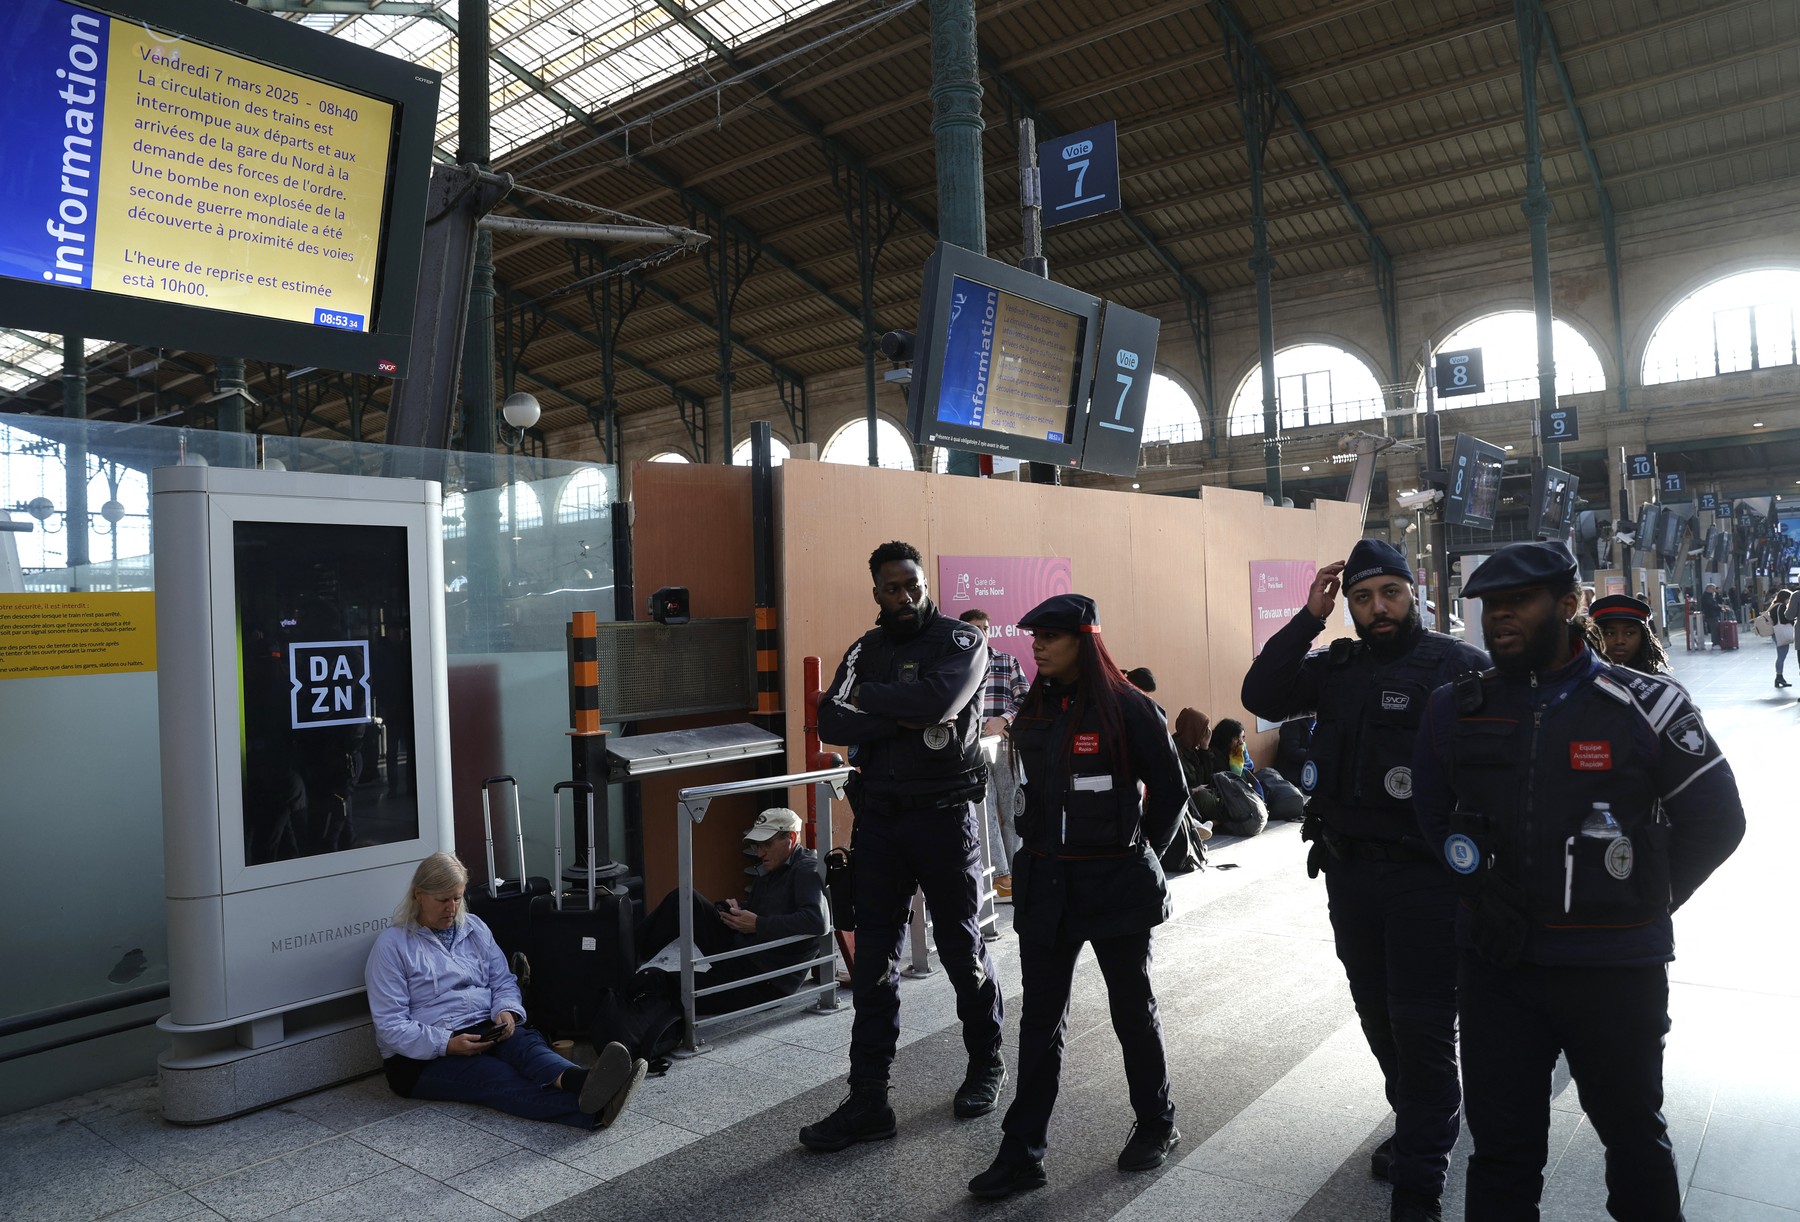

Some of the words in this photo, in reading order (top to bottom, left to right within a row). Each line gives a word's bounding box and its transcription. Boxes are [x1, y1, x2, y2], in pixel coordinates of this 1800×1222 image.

[140, 46, 209, 79] Vendredi
[214, 68, 223, 82] 7
[227, 76, 261, 94] mars
[265, 84, 299, 105] 2025
[319, 100, 358, 122] 08h40
[138, 69, 156, 87] La
[161, 78, 240, 110] circulation
[245, 101, 268, 118] des
[273, 109, 310, 130] trains
[314, 123, 334, 136] est
[136, 92, 232, 130] interrompue
[235, 122, 260, 137] aux
[263, 128, 314, 152] départs
[317, 144, 331, 156] et
[334, 149, 356, 162] aux
[43, 13, 100, 285] information
[134, 118, 195, 142] arrivées
[199, 133, 217, 148] de
[221, 137, 233, 152] la
[237, 144, 267, 160] gare
[271, 152, 288, 166] du
[292, 155, 325, 175] Nord
[327, 165, 335, 178] à
[338, 167, 349, 181] la
[1066, 144, 1089, 158] Voie
[133, 138, 205, 167] demande
[208, 157, 233, 174] des
[237, 163, 279, 185] forces
[283, 176, 299, 189] de
[302, 179, 347, 201] l'ordre.
[1068, 159, 1090, 198] 7
[131, 160, 163, 179] Une
[167, 168, 219, 192] bombe
[223, 184, 250, 199] non
[254, 191, 312, 213] explosée
[315, 204, 331, 217] de
[334, 207, 345, 220] la
[129, 185, 193, 208] seconde
[196, 200, 243, 219] guerre
[246, 211, 309, 233] mondiale
[311, 225, 319, 235] a
[322, 225, 343, 240] été
[128, 206, 213, 234] découverte
[216, 223, 224, 236] à
[228, 228, 294, 250] proximité
[297, 240, 319, 255] des
[322, 248, 354, 262] voies
[124, 249, 180, 271] L'heure
[184, 261, 202, 275] de
[206, 267, 254, 284] reprise
[257, 276, 278, 288] est
[281, 280, 332, 297] estimée
[122, 274, 155, 289] està
[161, 277, 209, 297] 10h00.
[320, 312, 348, 327] 08:53
[348, 320, 358, 328] 34
[378, 363, 396, 371] SNCF
[969, 291, 997, 427] information
[1120, 352, 1136, 368] Voie
[1451, 356, 1468, 364] Voie
[1453, 366, 1468, 386] 8
[1114, 373, 1133, 421] 7
[1553, 420, 1565, 435] 9
[1632, 461, 1650, 474] 10
[1666, 478, 1681, 489] 11
[1702, 498, 1714, 508] 12
[1719, 507, 1730, 516] 13
[974, 577, 988, 586] Gare
[988, 577, 996, 586] de
[974, 588, 989, 596] Paris
[990, 586, 1004, 596] Nord
[1258, 606, 1282, 620] Travaux
[1284, 607, 1291, 618] en
[105, 640, 120, 648] après
[310, 654, 354, 682] DA
[1638, 682, 1648, 690] DE
[1639, 682, 1661, 700] MISSION
[310, 685, 352, 713] ZN
[1384, 696, 1407, 704] SNCF
[1574, 752, 1609, 760] Assistance
[1579, 744, 1602, 753] Equipe
[1580, 760, 1604, 769] Rapide
